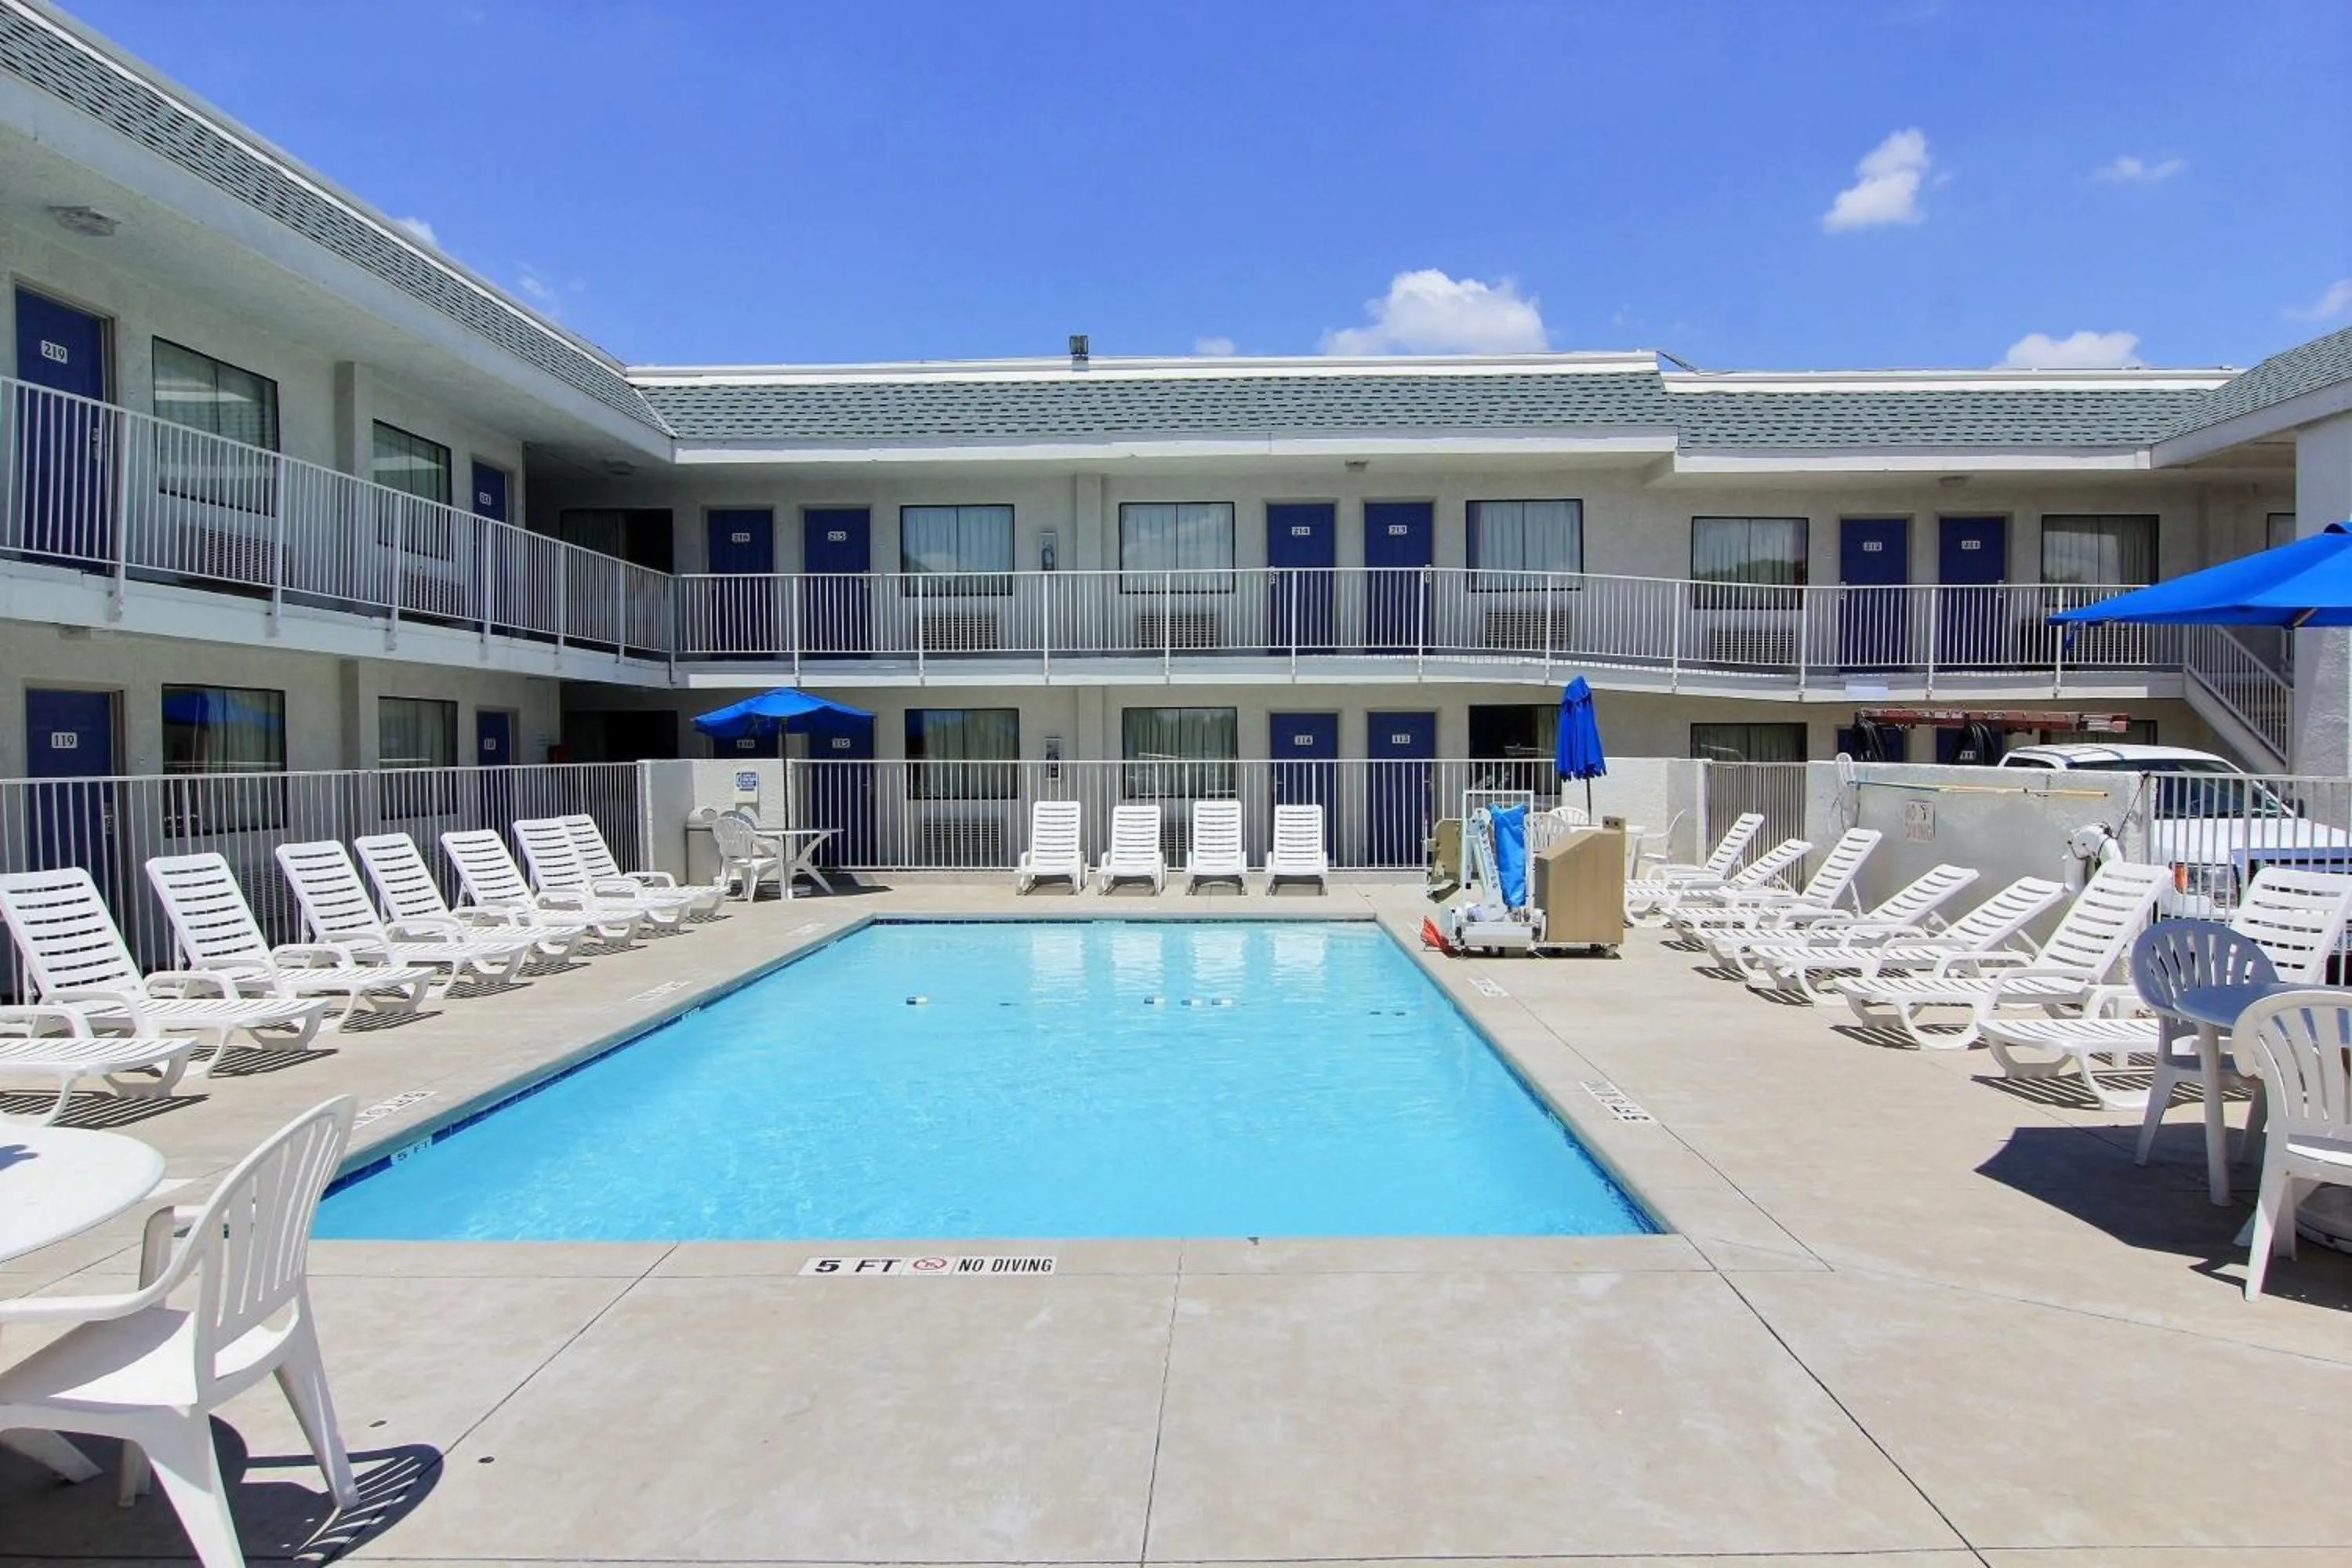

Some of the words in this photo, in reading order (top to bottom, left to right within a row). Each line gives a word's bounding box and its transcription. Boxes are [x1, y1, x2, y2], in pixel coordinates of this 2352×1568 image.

[43, 343, 66, 361] 219
[53, 734, 75, 747] 119
[815, 1260, 841, 1272] 5
[855, 1258, 902, 1272] FT
[957, 1258, 985, 1272] NO
[991, 1258, 1054, 1272] DIVING
